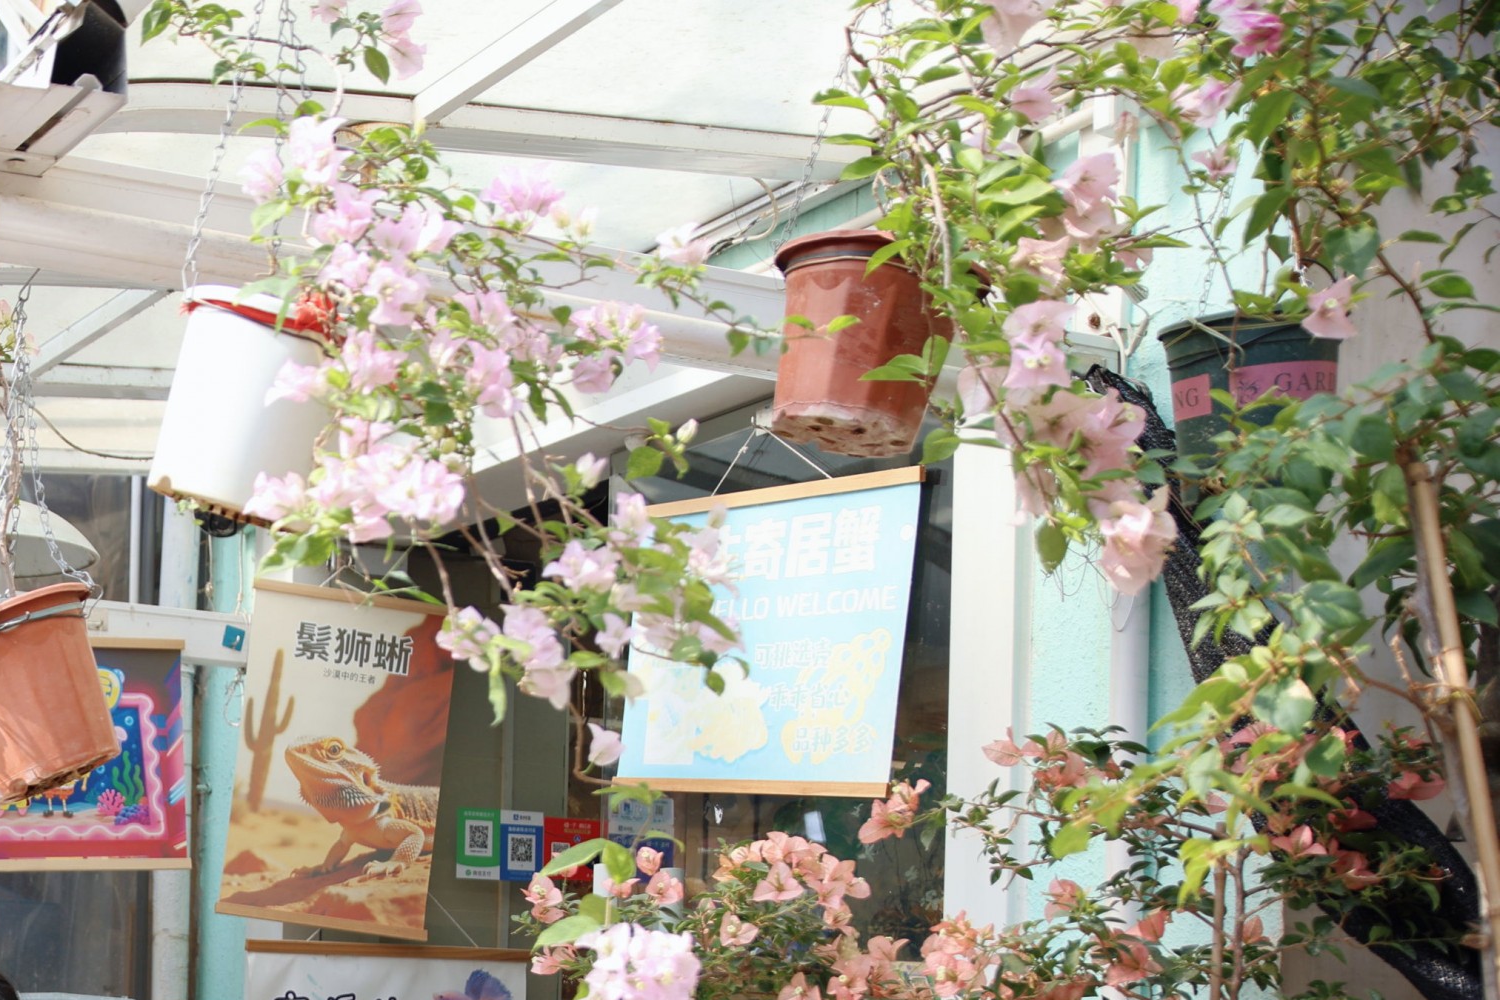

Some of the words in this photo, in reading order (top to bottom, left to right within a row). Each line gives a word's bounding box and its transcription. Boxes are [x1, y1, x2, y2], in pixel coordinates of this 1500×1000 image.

[777, 585, 899, 618] WELCOME
[323, 667, 376, 685] 沙漠中的王者
[792, 722, 874, 754] 品种多多
